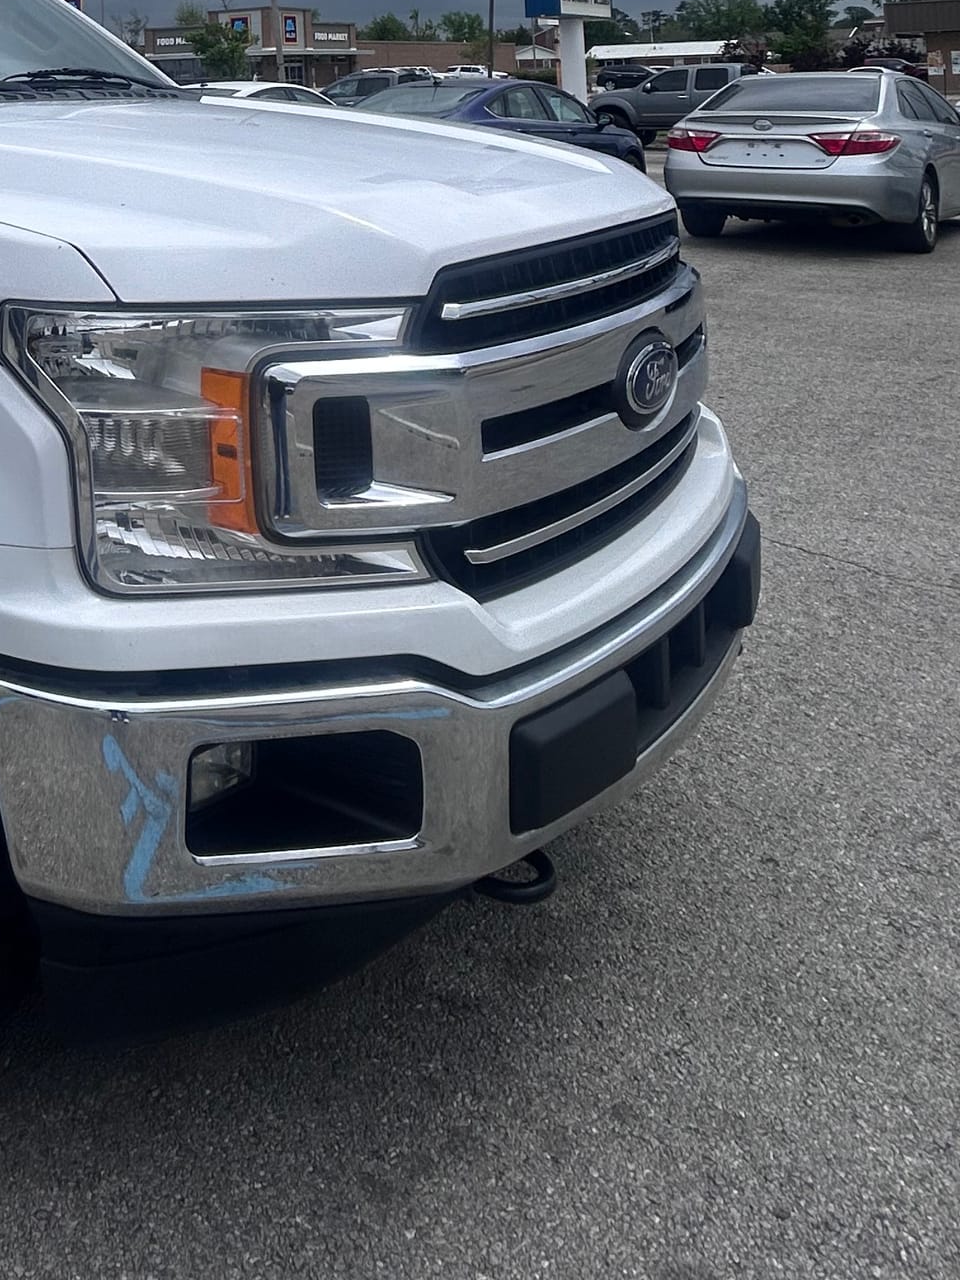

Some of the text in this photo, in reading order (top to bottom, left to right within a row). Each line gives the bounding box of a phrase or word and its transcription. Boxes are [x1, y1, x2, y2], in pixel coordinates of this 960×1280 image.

[314, 31, 348, 41] FOOD MARKET
[156, 37, 175, 46] FOOD
